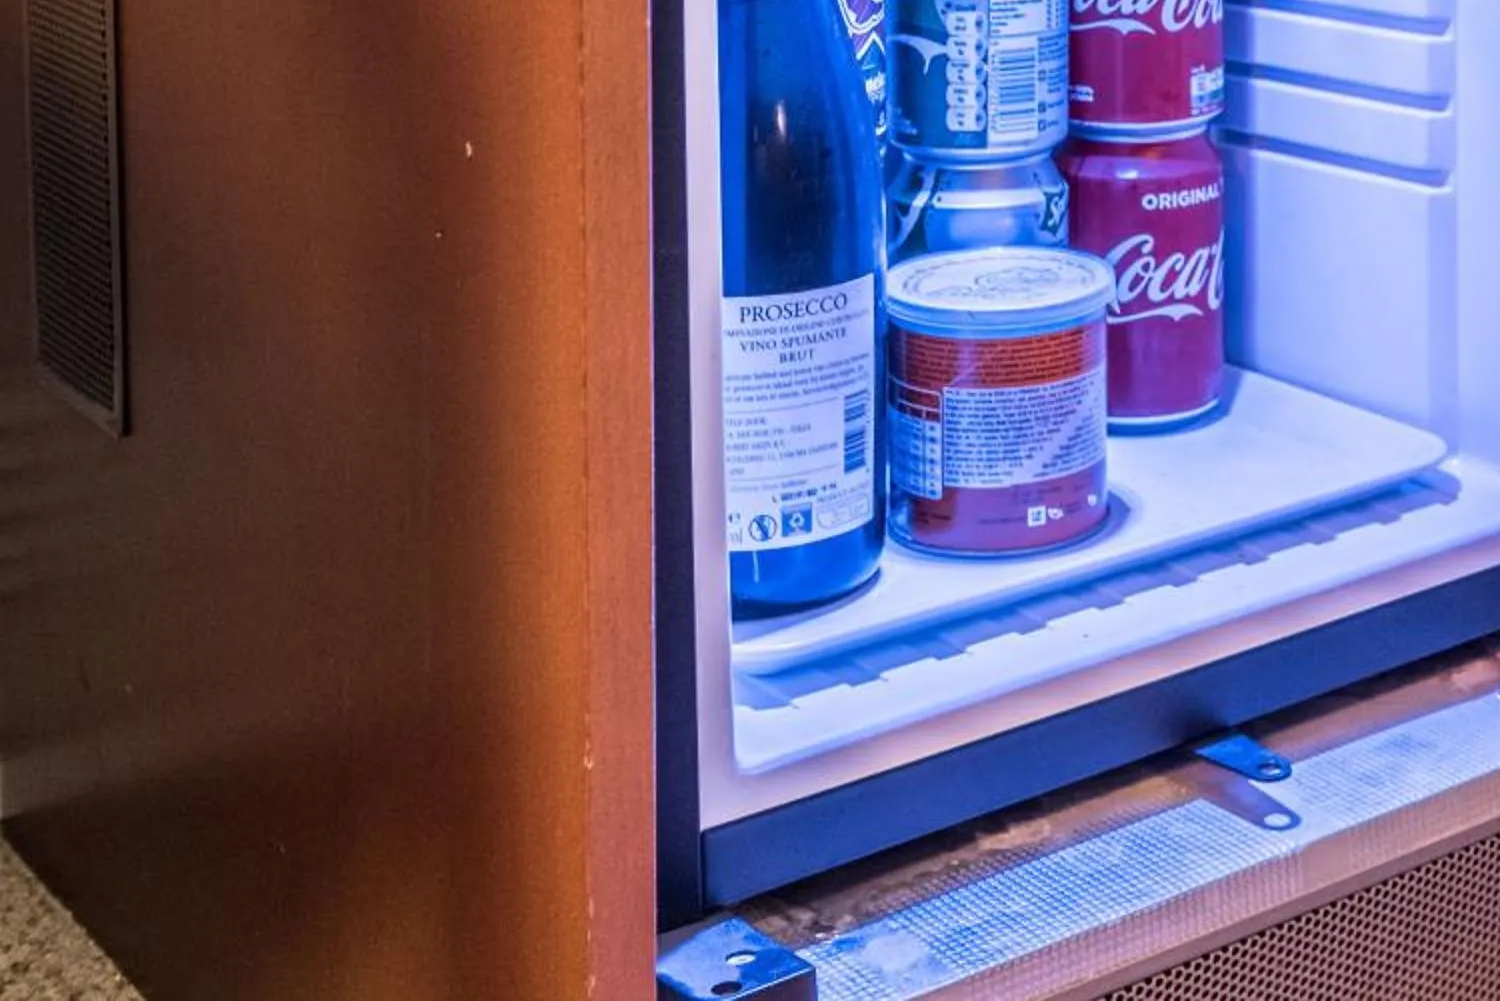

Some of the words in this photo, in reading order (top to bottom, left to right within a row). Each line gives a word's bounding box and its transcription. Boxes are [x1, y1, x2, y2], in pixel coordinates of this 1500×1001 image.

[739, 293, 847, 323] PROSECCO
[739, 339, 777, 352] VINO
[781, 327, 848, 349] SPUMANTE
[779, 349, 815, 364] BRUT
